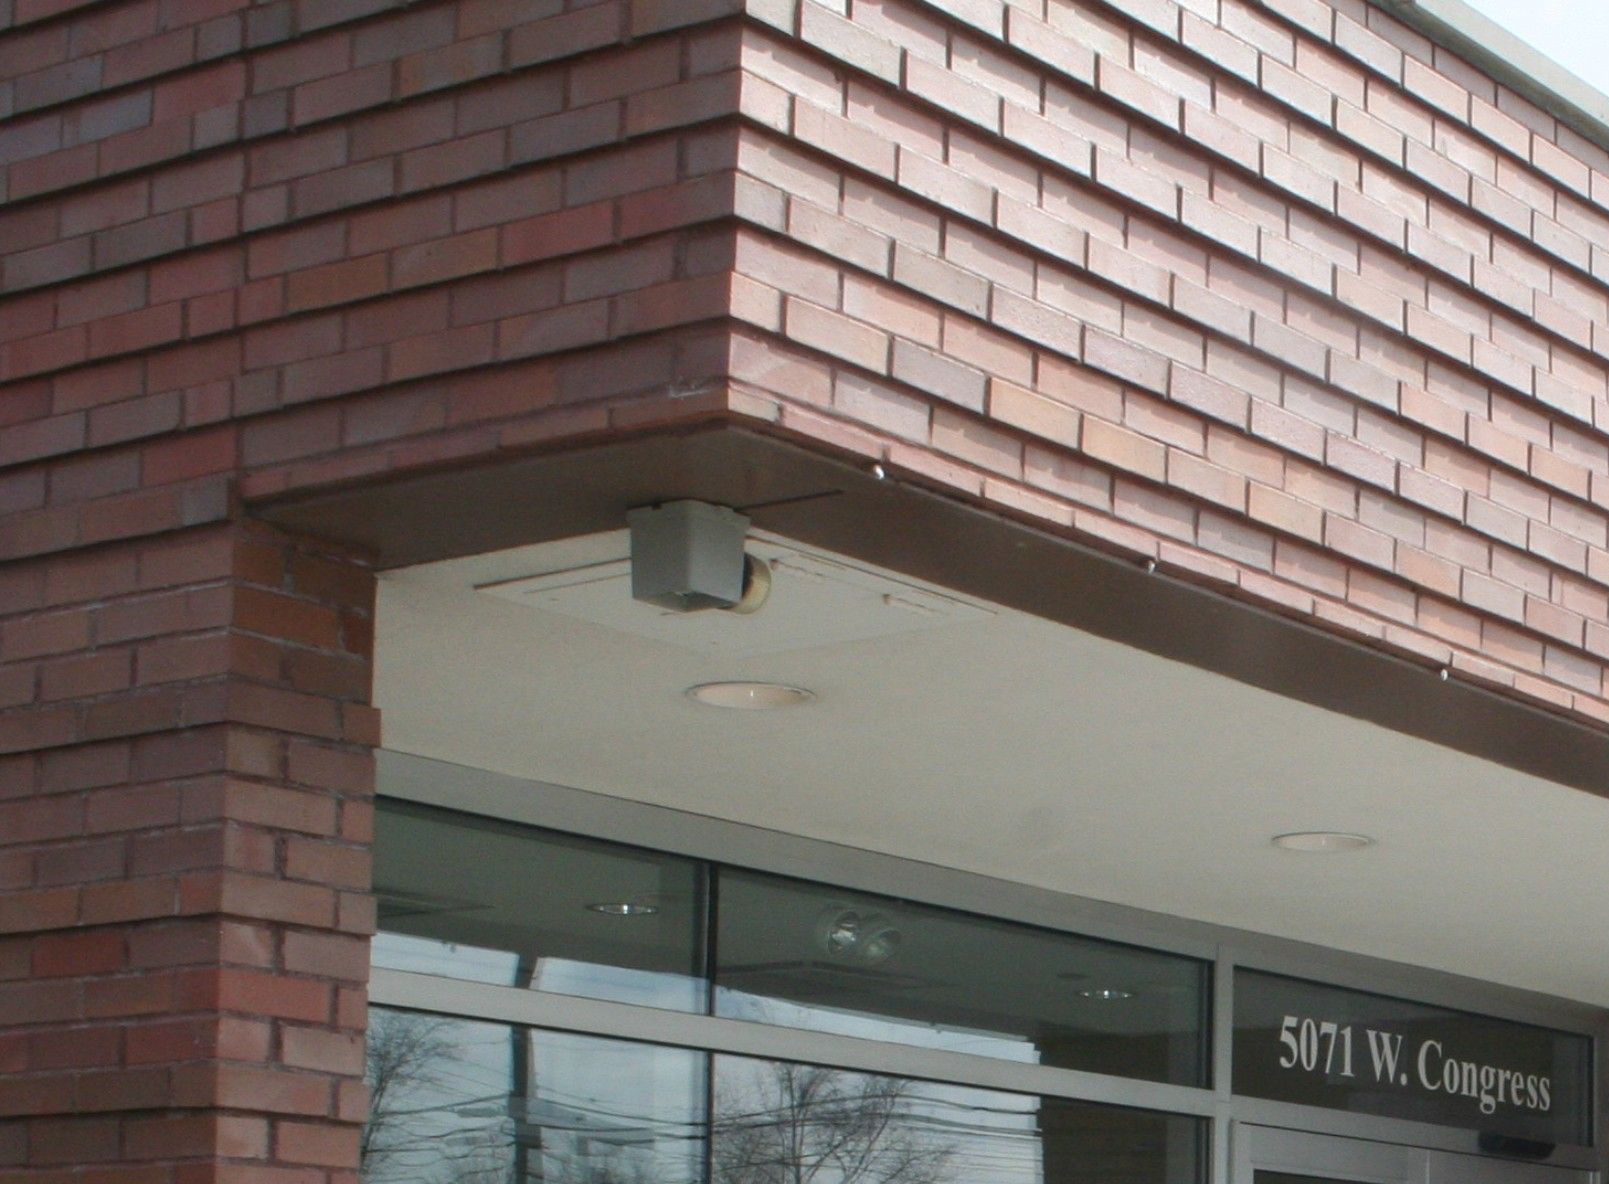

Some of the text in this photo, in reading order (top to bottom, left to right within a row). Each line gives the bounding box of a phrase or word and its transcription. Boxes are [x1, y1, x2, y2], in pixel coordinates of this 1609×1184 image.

[1279, 1015, 1551, 1114] 5071 W. Congress
